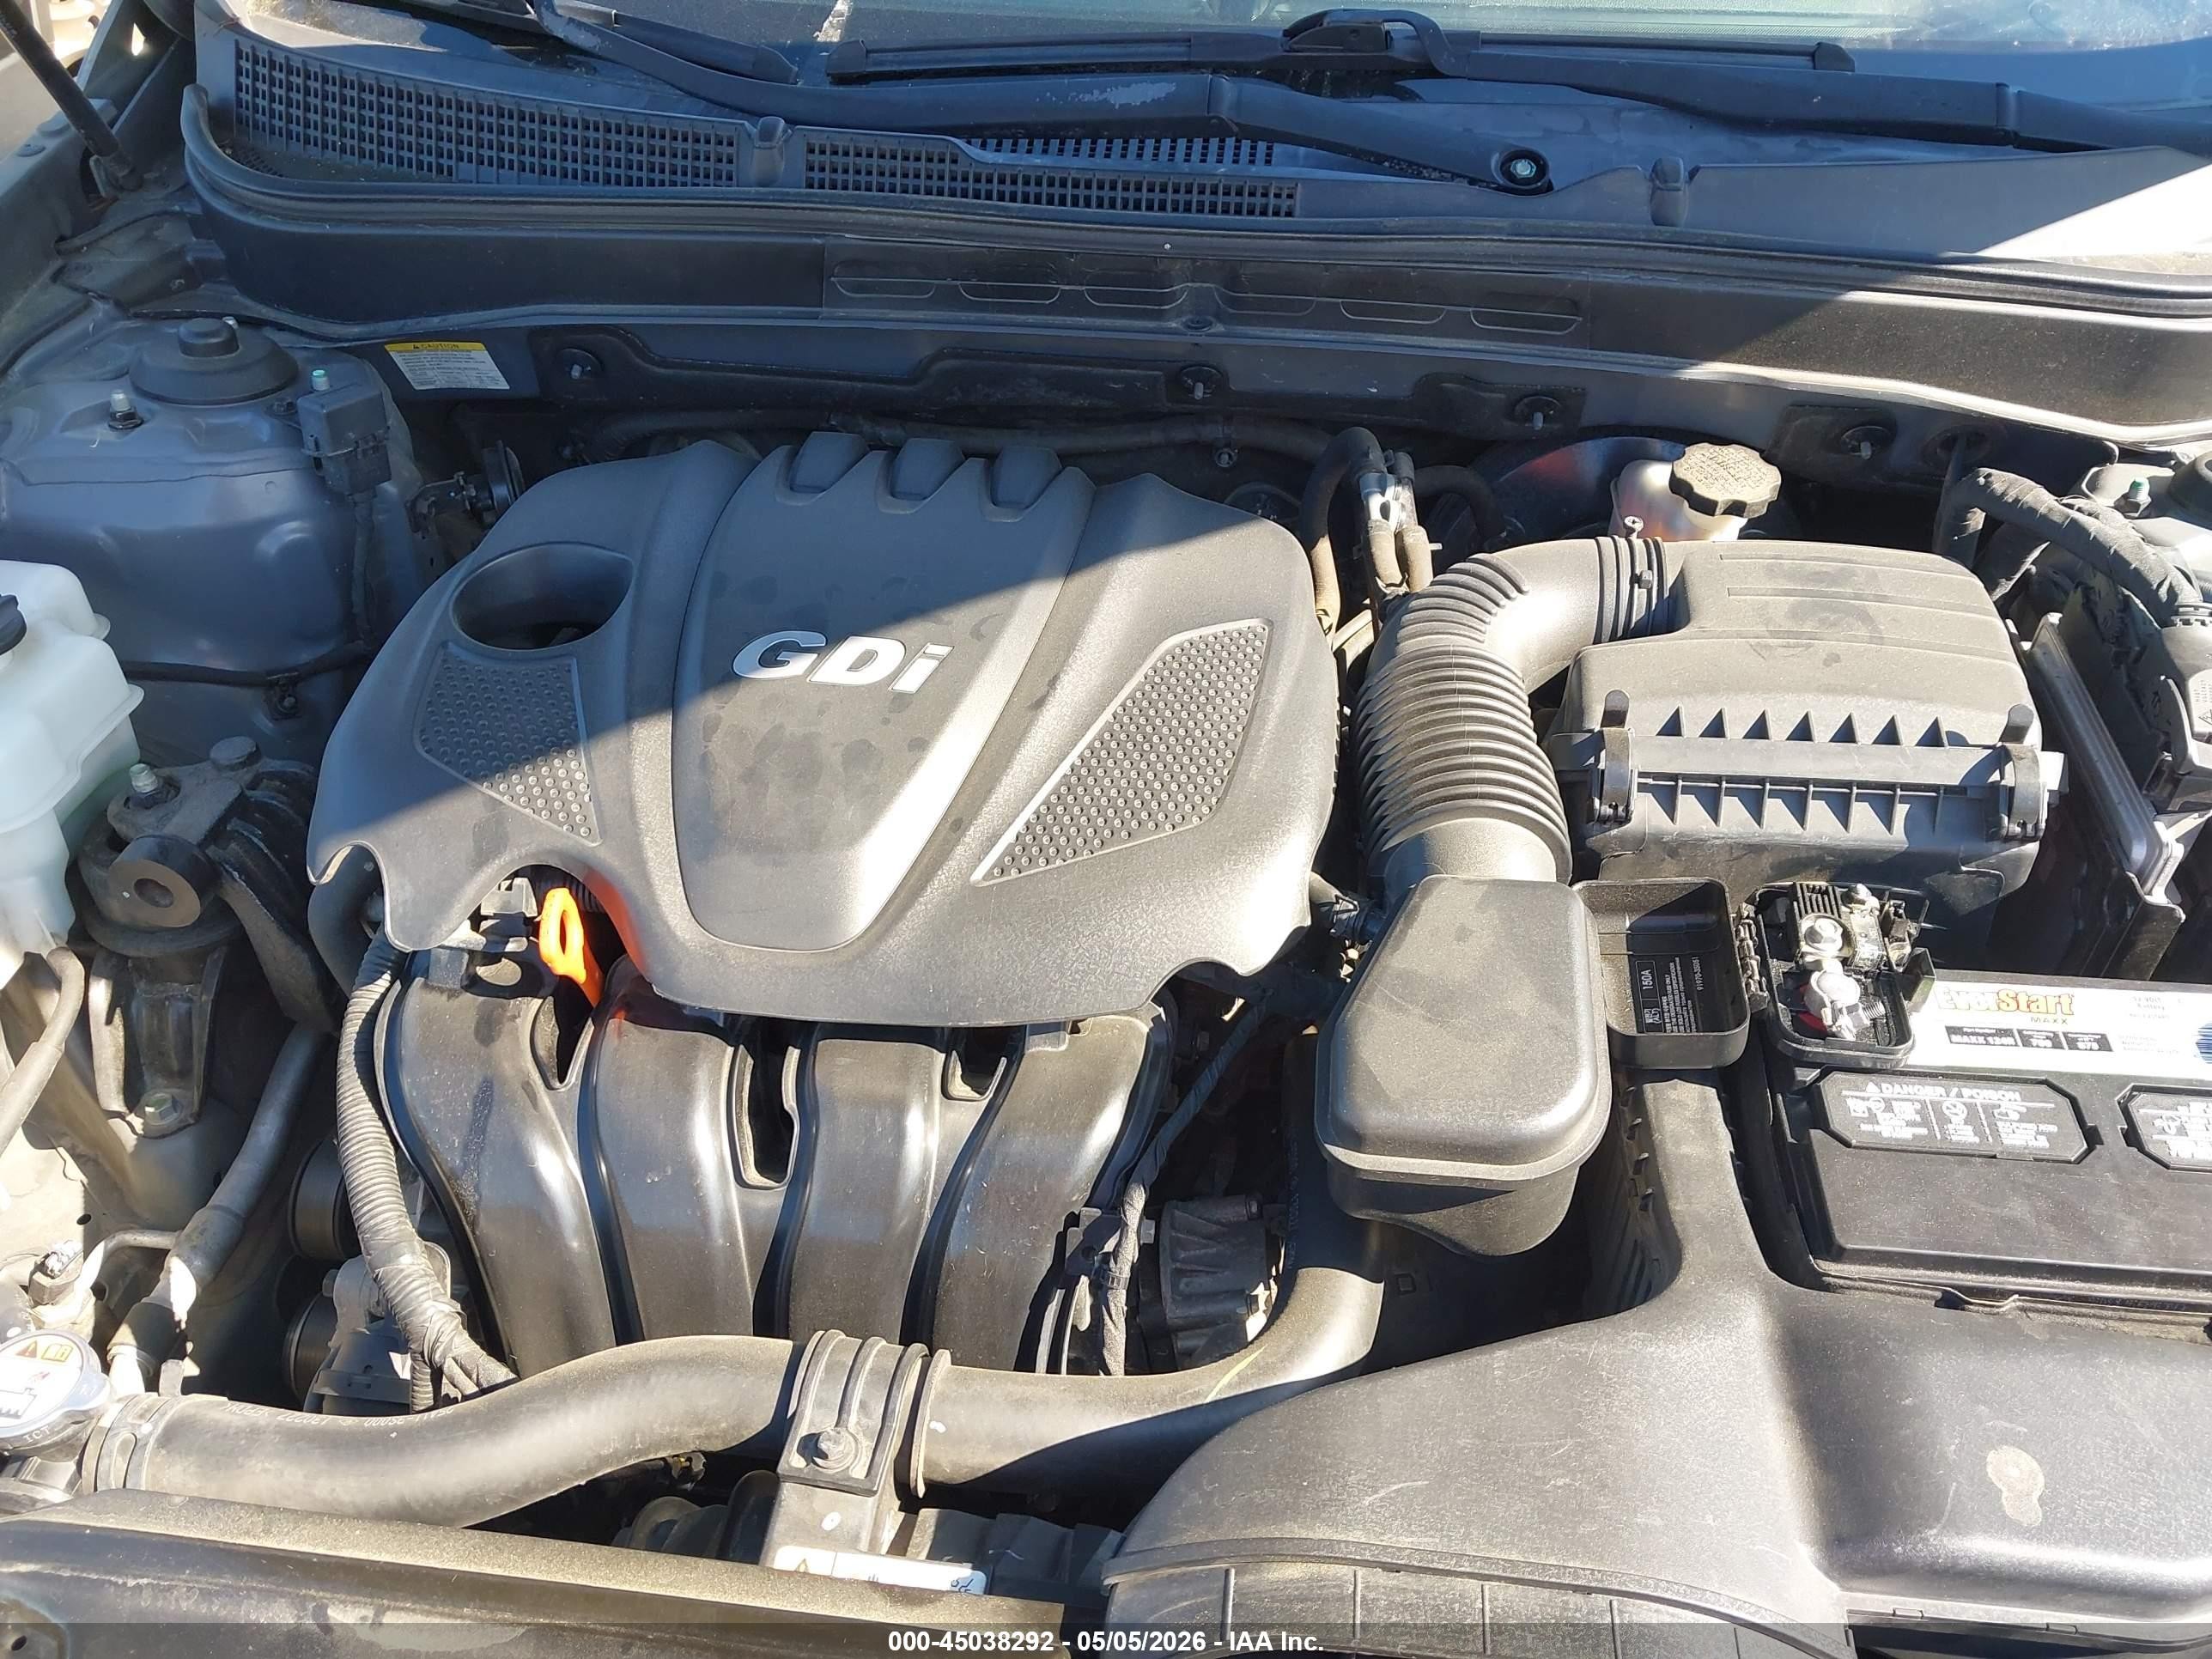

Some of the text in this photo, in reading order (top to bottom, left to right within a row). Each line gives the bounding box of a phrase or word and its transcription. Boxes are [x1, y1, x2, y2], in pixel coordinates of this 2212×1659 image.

[732, 629, 955, 695] GDi
[1641, 969, 1654, 990] 150A
[1651, 1007, 1662, 1024] (ALT)
[2030, 1016, 2069, 1024] MAXX
[1881, 1083, 1947, 1098] DANGER
